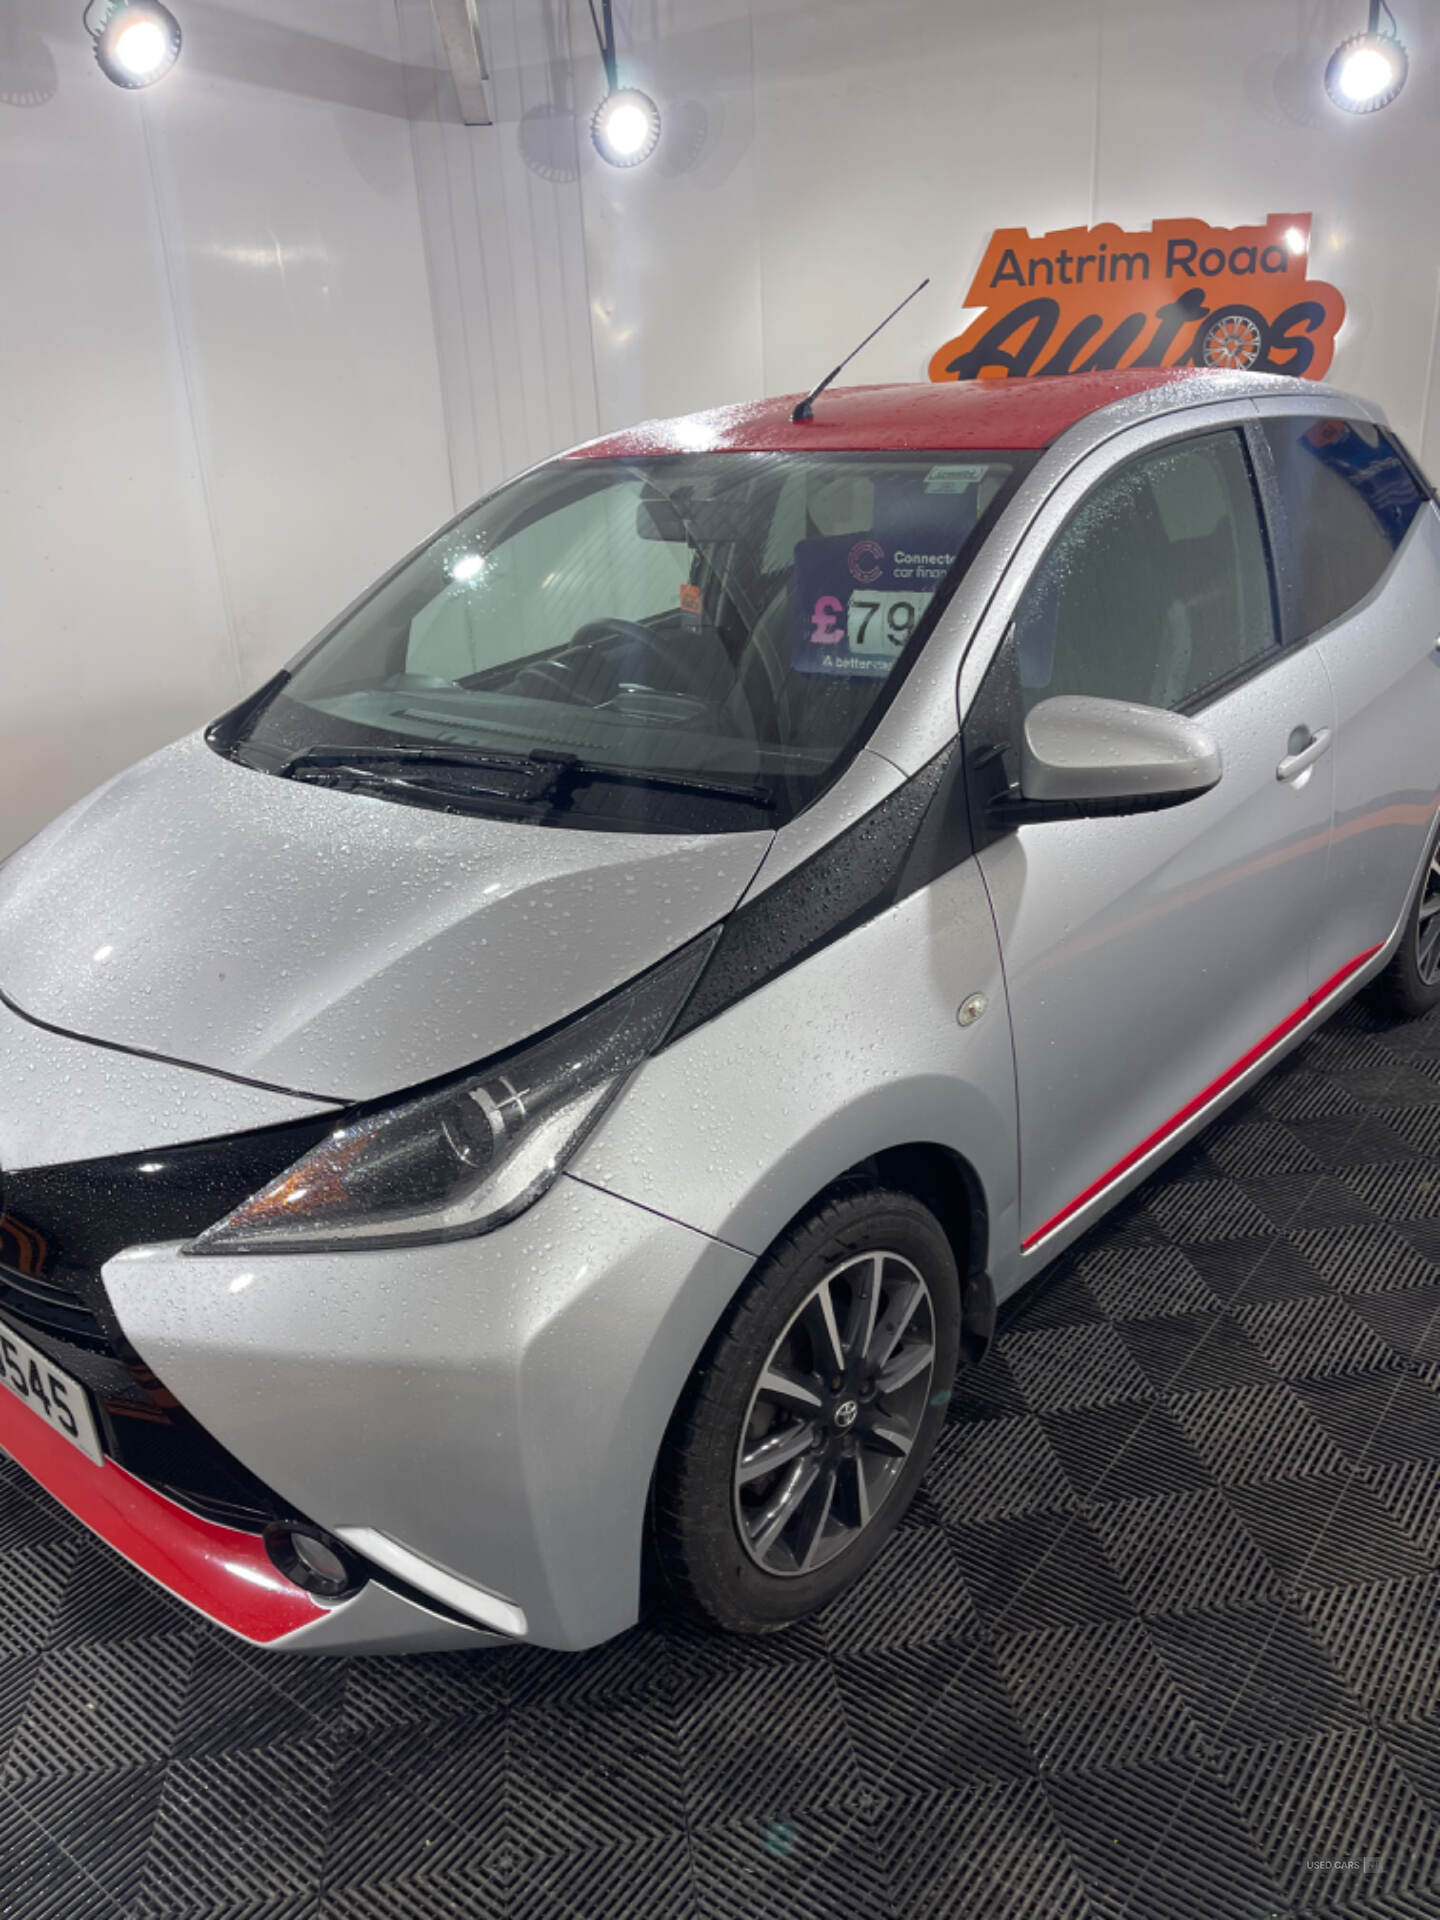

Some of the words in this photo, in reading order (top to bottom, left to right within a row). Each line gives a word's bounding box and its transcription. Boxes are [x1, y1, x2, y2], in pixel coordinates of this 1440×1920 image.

[990, 244, 1149, 288] Antrim
[1165, 238, 1288, 279] Road
[945, 288, 1326, 379] Autos
[0, 1336, 78, 1438] 545
